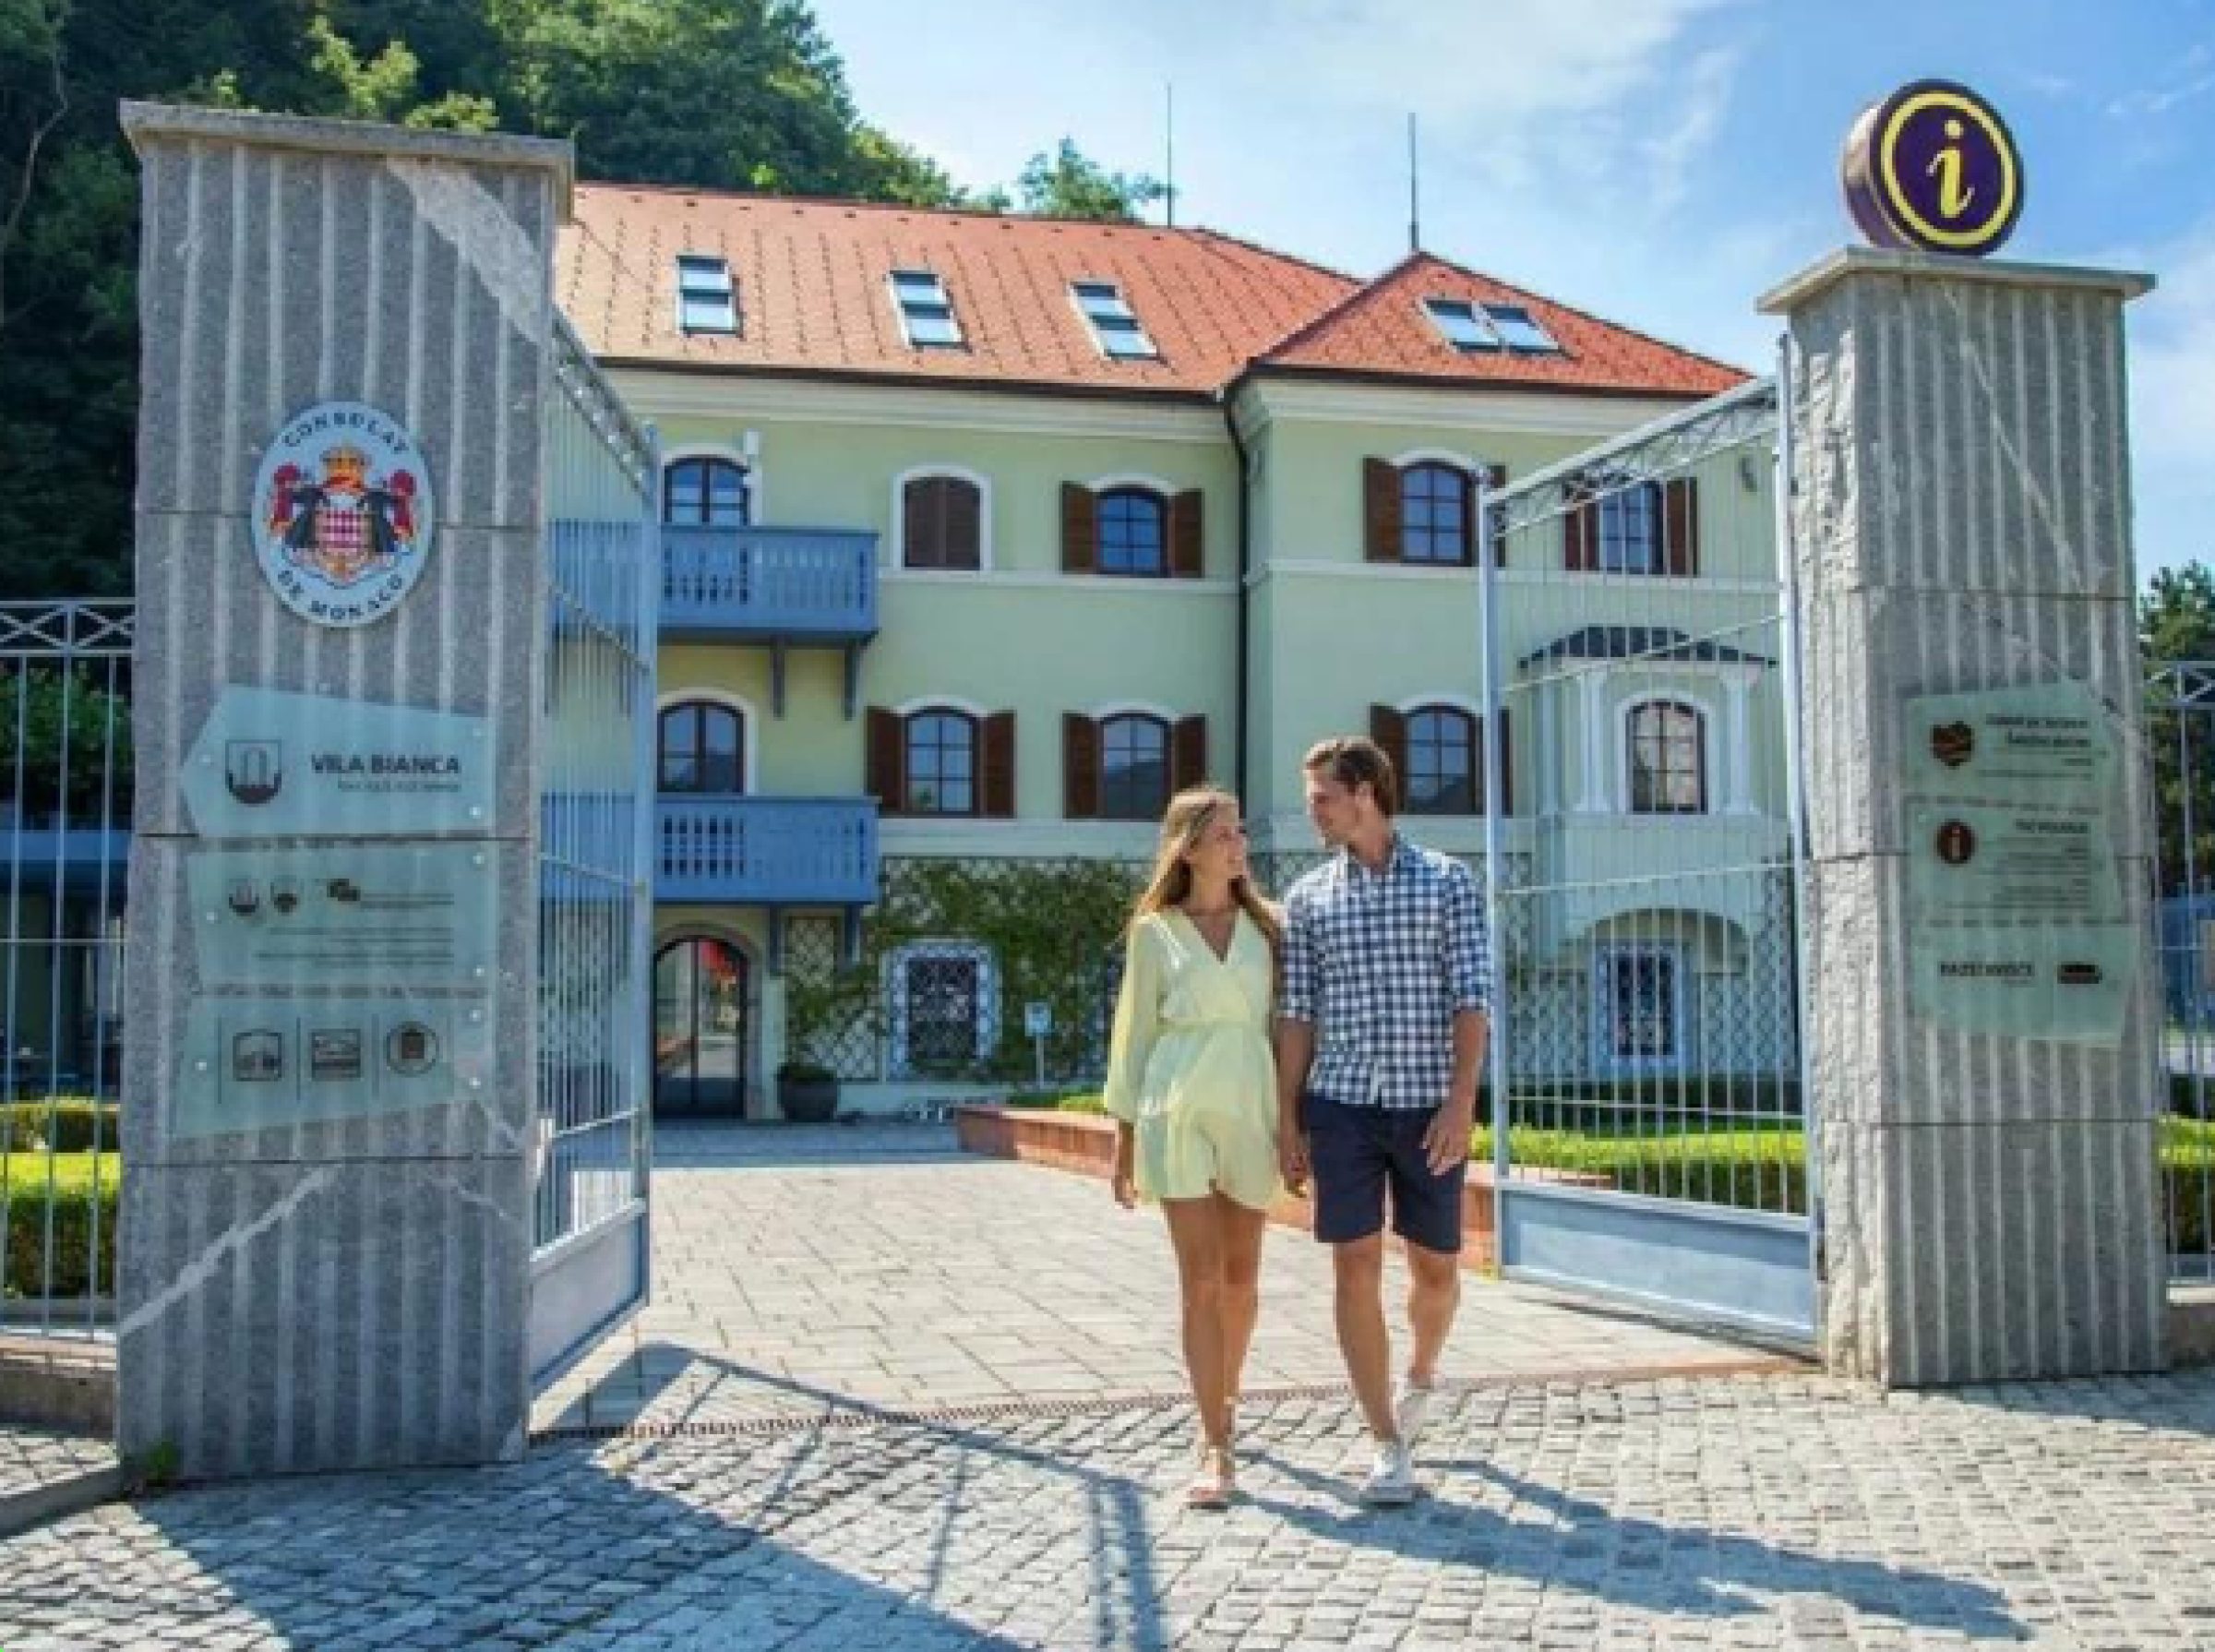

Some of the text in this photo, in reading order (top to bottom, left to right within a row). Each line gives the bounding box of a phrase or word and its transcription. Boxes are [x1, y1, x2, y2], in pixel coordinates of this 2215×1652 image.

[282, 412, 409, 454] CONSULAT
[278, 569, 403, 620] DE MONACO
[311, 753, 459, 773] VILA BIANCA
